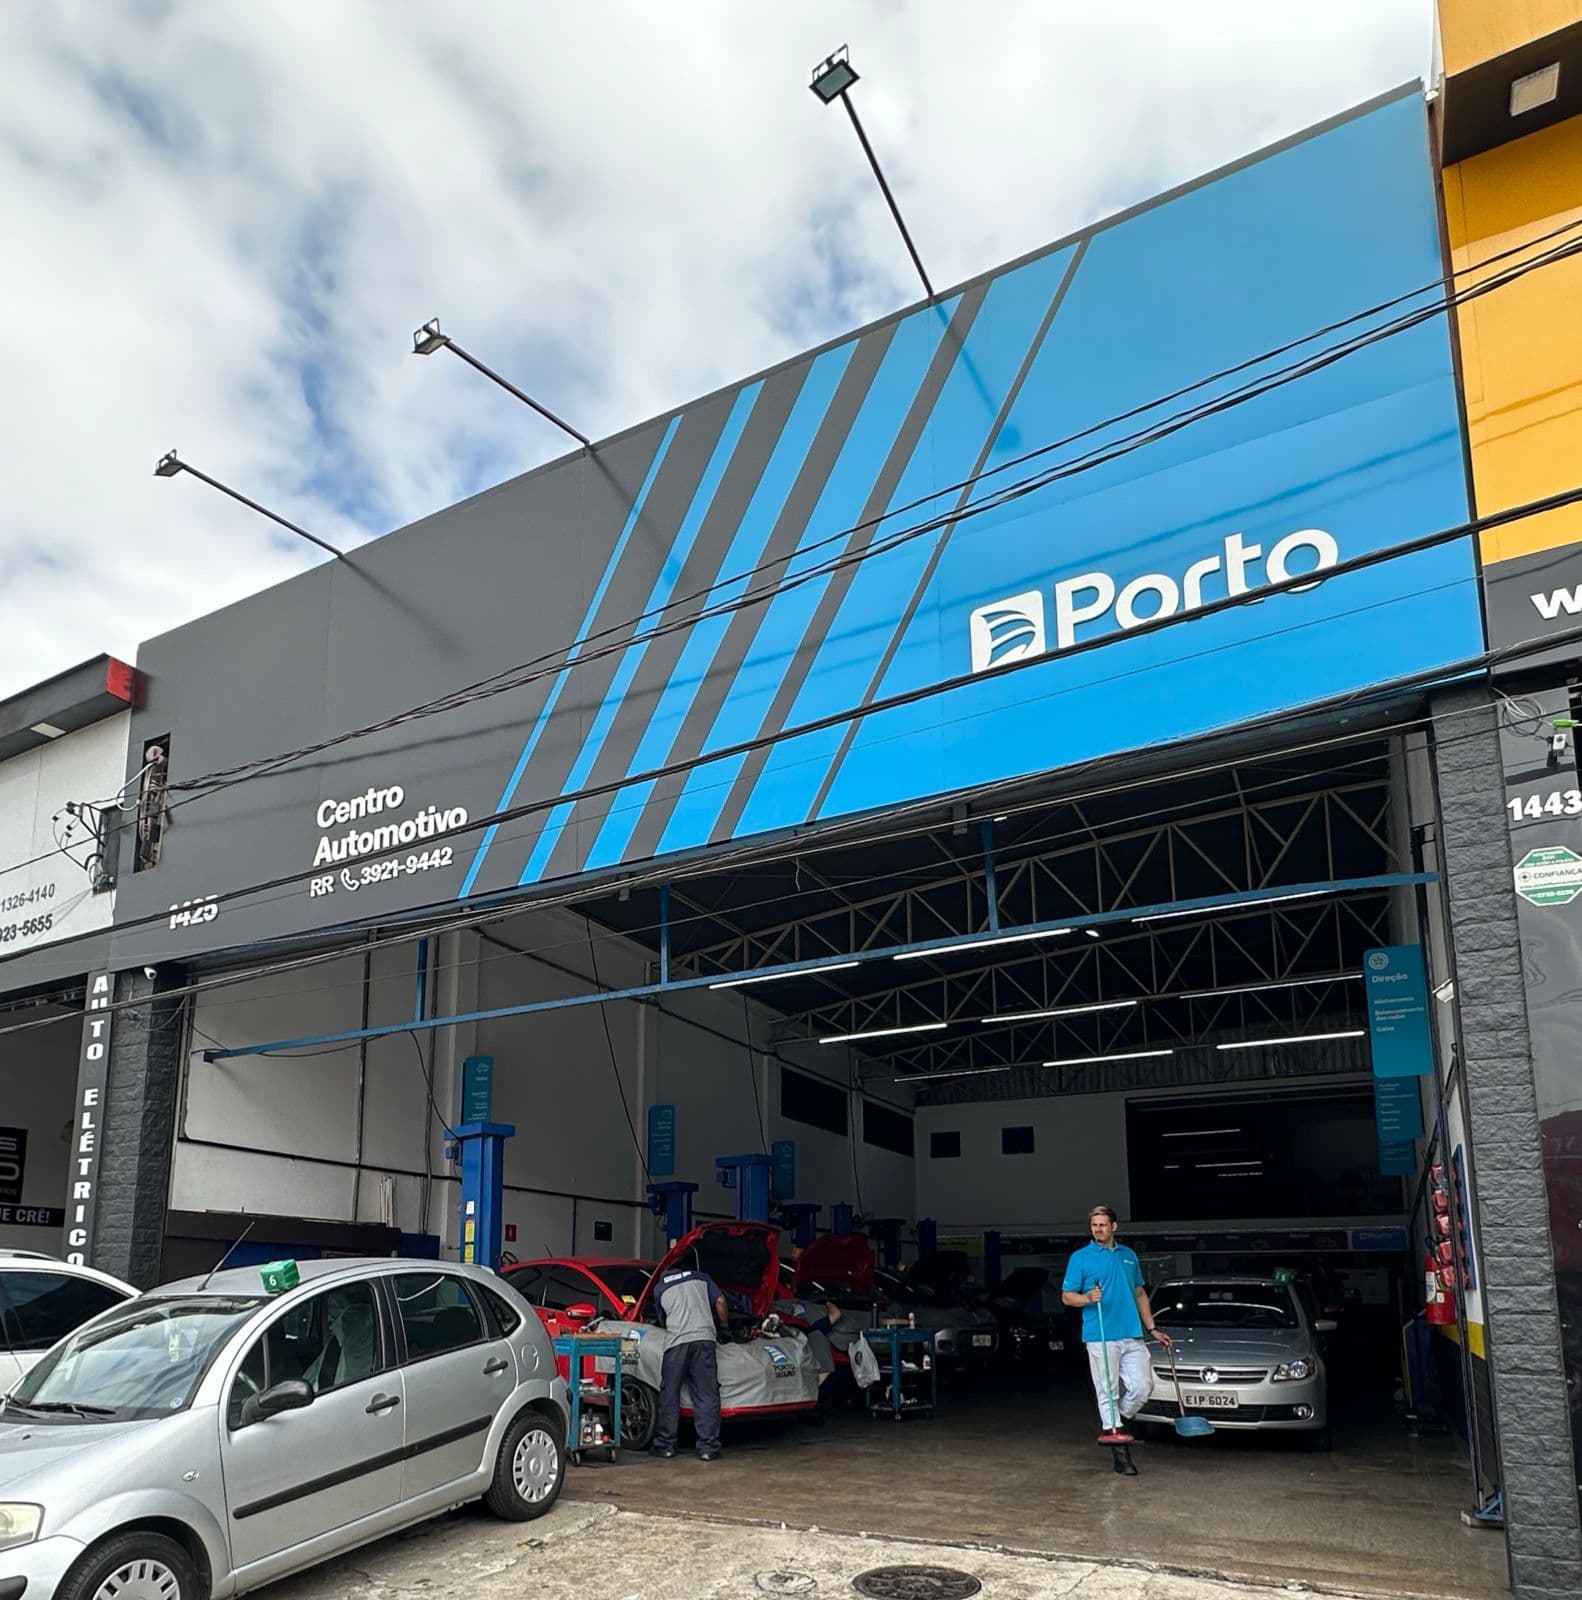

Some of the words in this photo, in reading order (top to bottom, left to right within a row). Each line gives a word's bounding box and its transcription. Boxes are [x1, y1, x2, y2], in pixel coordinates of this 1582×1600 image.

[1054, 528, 1339, 650] Porto
[316, 785, 404, 829] Centro
[1507, 790, 1582, 821] 1443
[312, 805, 468, 868] Automotivo
[310, 875, 335, 898] RR
[360, 846, 453, 885] 3921-9442
[169, 894, 218, 930] 1425
[1372, 972, 1408, 983] Direção
[0, 1208, 11, 1221] E
[269, 1275, 277, 1287] 6
[1185, 1395, 1206, 1405] EIP
[1208, 1395, 1236, 1406] 6024
